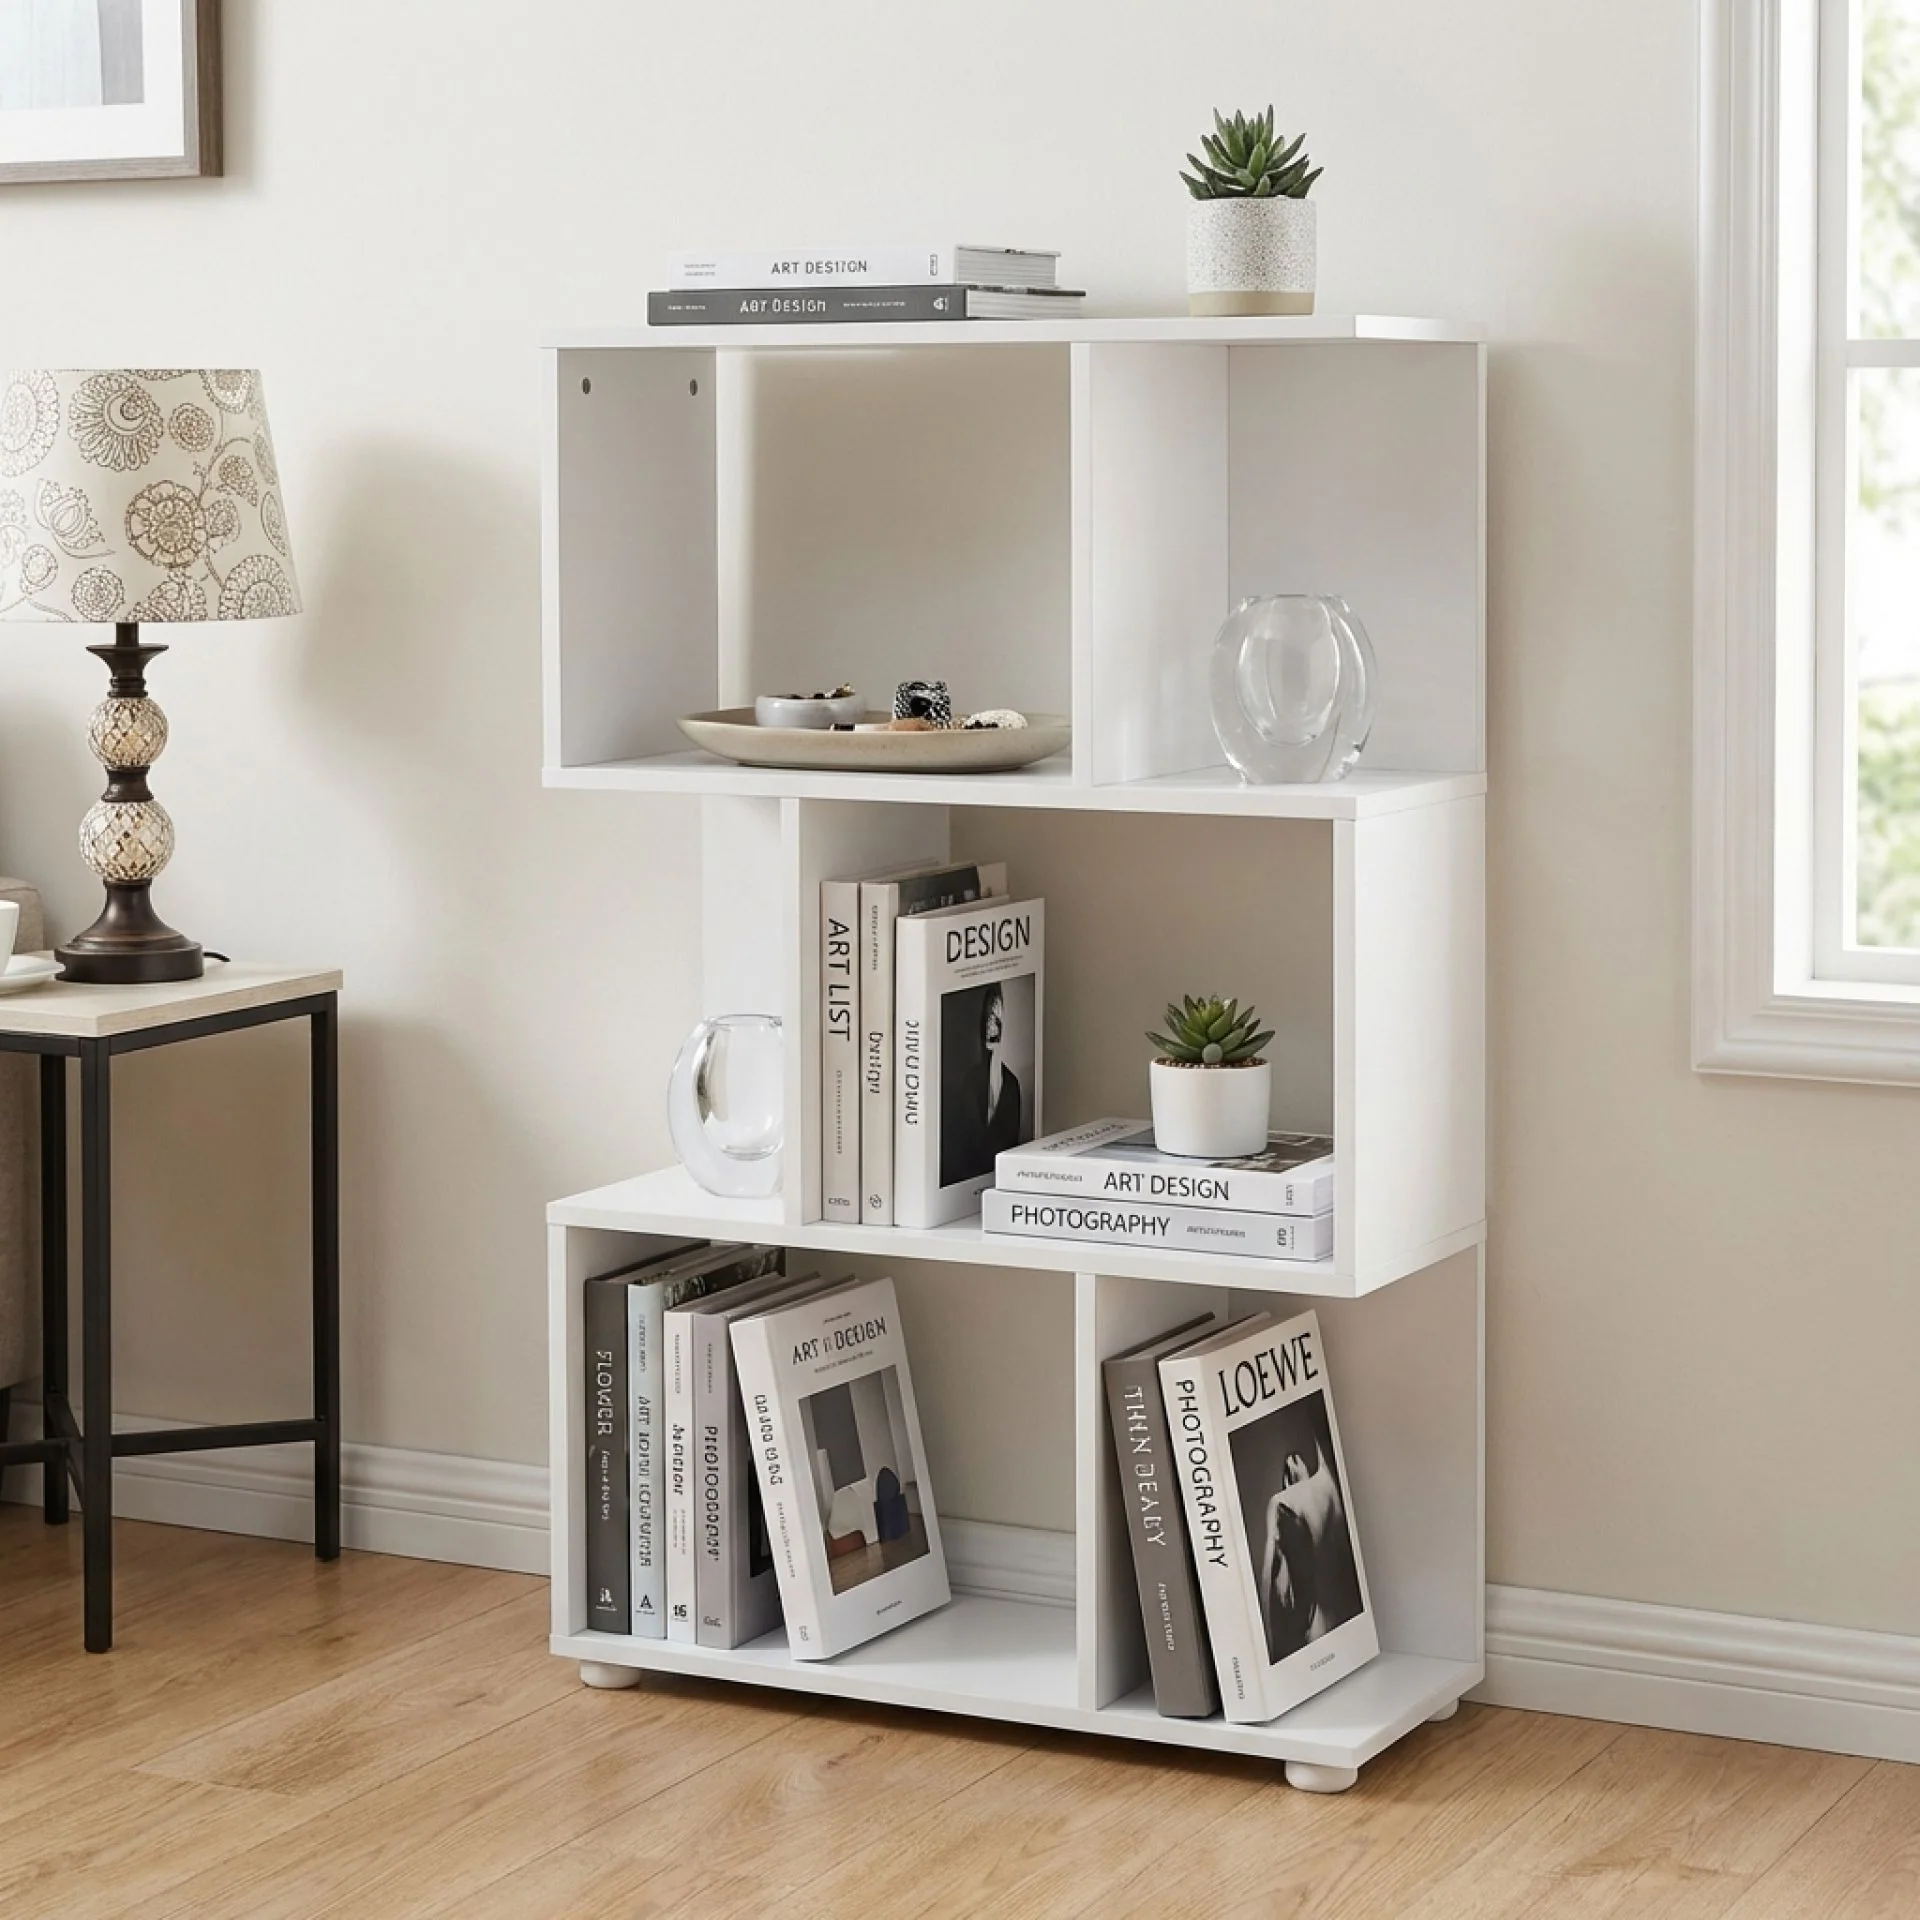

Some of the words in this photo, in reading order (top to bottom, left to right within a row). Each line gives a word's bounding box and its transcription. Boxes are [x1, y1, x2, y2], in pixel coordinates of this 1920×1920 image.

[771, 261, 800, 275] ART
[828, 918, 850, 975] ART
[946, 914, 1031, 963] DESIGN
[828, 984, 850, 1041] LIST
[1104, 1171, 1145, 1193] ART
[1150, 1174, 1230, 1201] DESIGN
[1011, 1204, 1171, 1236] PHOTOGRAPHY
[792, 1338, 819, 1366] ART
[1218, 1332, 1319, 1418] LOEWE
[1175, 1379, 1229, 1568] PHOTOGRAPHY
